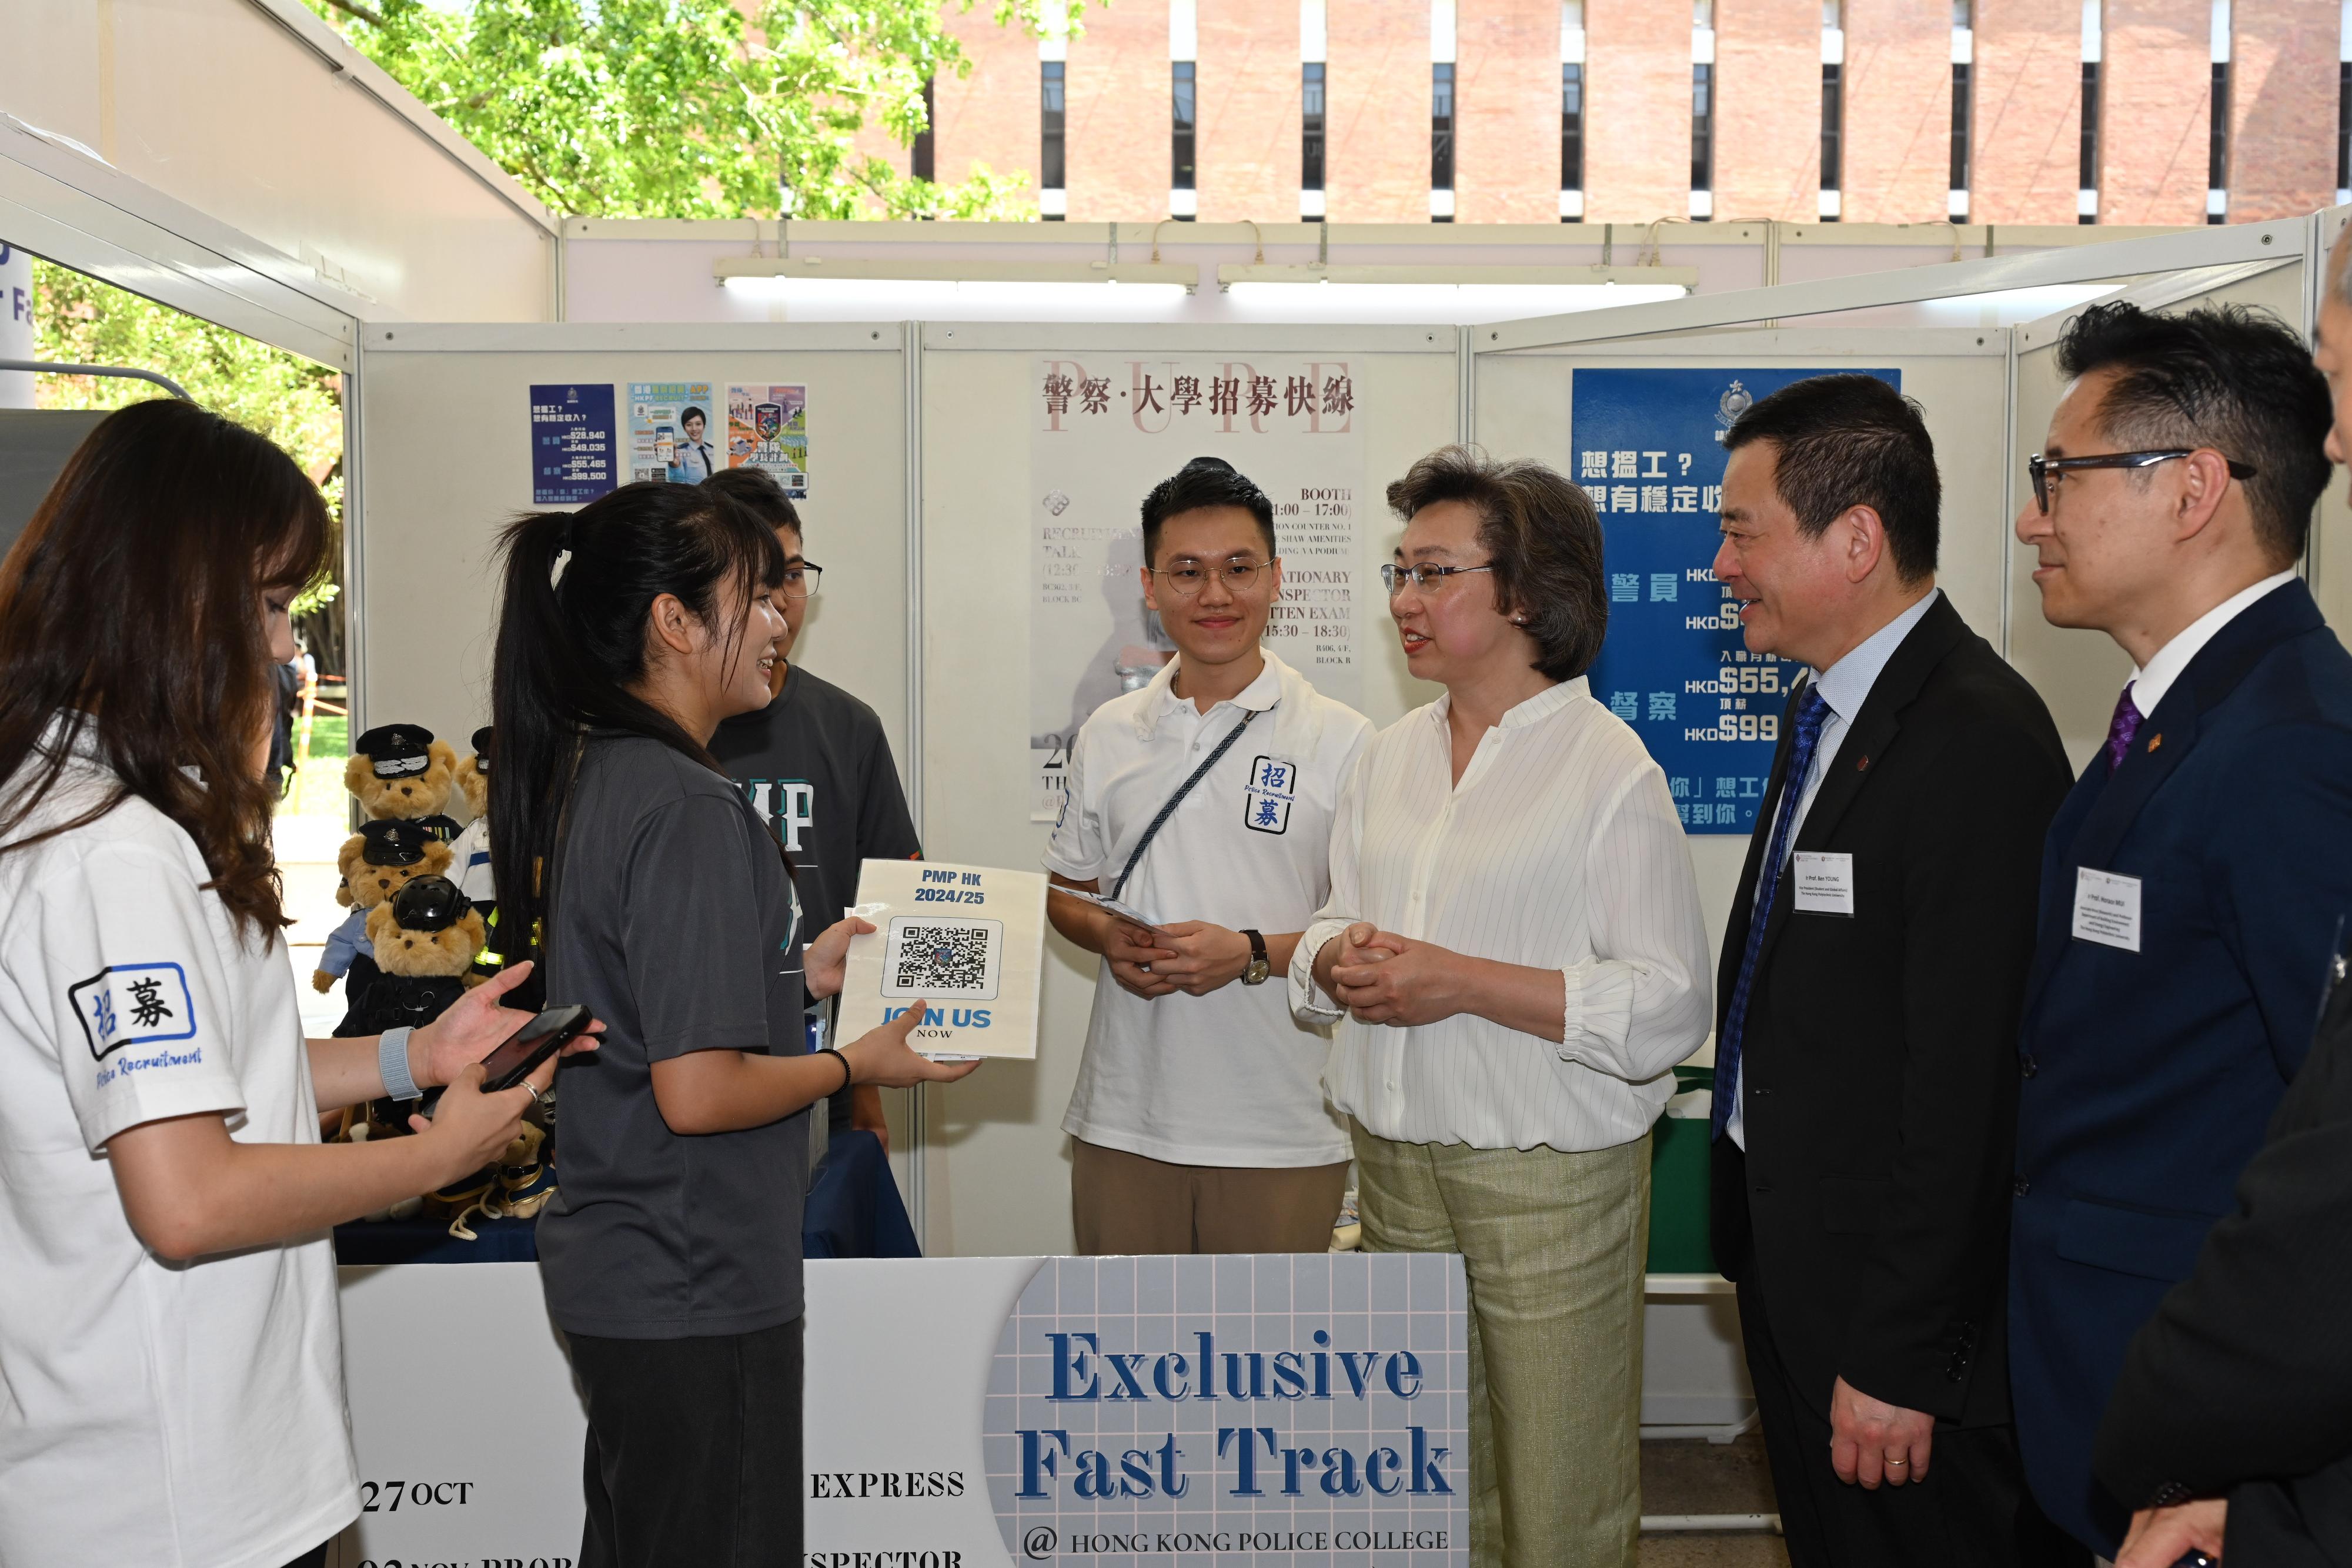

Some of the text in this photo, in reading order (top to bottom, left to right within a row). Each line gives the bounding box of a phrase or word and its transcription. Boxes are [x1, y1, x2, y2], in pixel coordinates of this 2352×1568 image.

[1042, 373, 1354, 417] 警察·大學招募快線
[1043, 360, 1351, 434] PURE
[1581, 450, 1692, 479] 想搵工？
[1300, 488, 1351, 500] BOOTH
[1273, 503, 1299, 516] 1:00
[1315, 503, 1351, 520] 17:00)
[1611, 573, 1678, 603] 警員
[1310, 607, 1350, 619] EXAM
[1686, 602, 1745, 630] HKD$
[1314, 625, 1350, 641] 18:30)
[1720, 650, 1791, 663] 入職月薪
[1611, 691, 1676, 721] 督察
[1720, 698, 1746, 710] 頂薪
[1261, 763, 1286, 788] 招
[1262, 789, 1295, 801] Recruitment
[1254, 798, 1278, 826] 募
[922, 870, 981, 886] PMP HK
[914, 888, 985, 905] 2024/25
[881, 1007, 991, 1028] JN US
[917, 1029, 953, 1038] NOW
[118, 1047, 202, 1076] Recruitment
[1045, 1330, 1423, 1402] Exclusive
[1015, 1427, 1456, 1500] Fast Track
[361, 1482, 474, 1512] 27 OCT
[810, 1472, 964, 1498] EXPRESS
[1024, 1526, 1448, 1560] @ HONG KONG POLICE COLLEGE
[804, 1552, 961, 1568] SPECTOR
